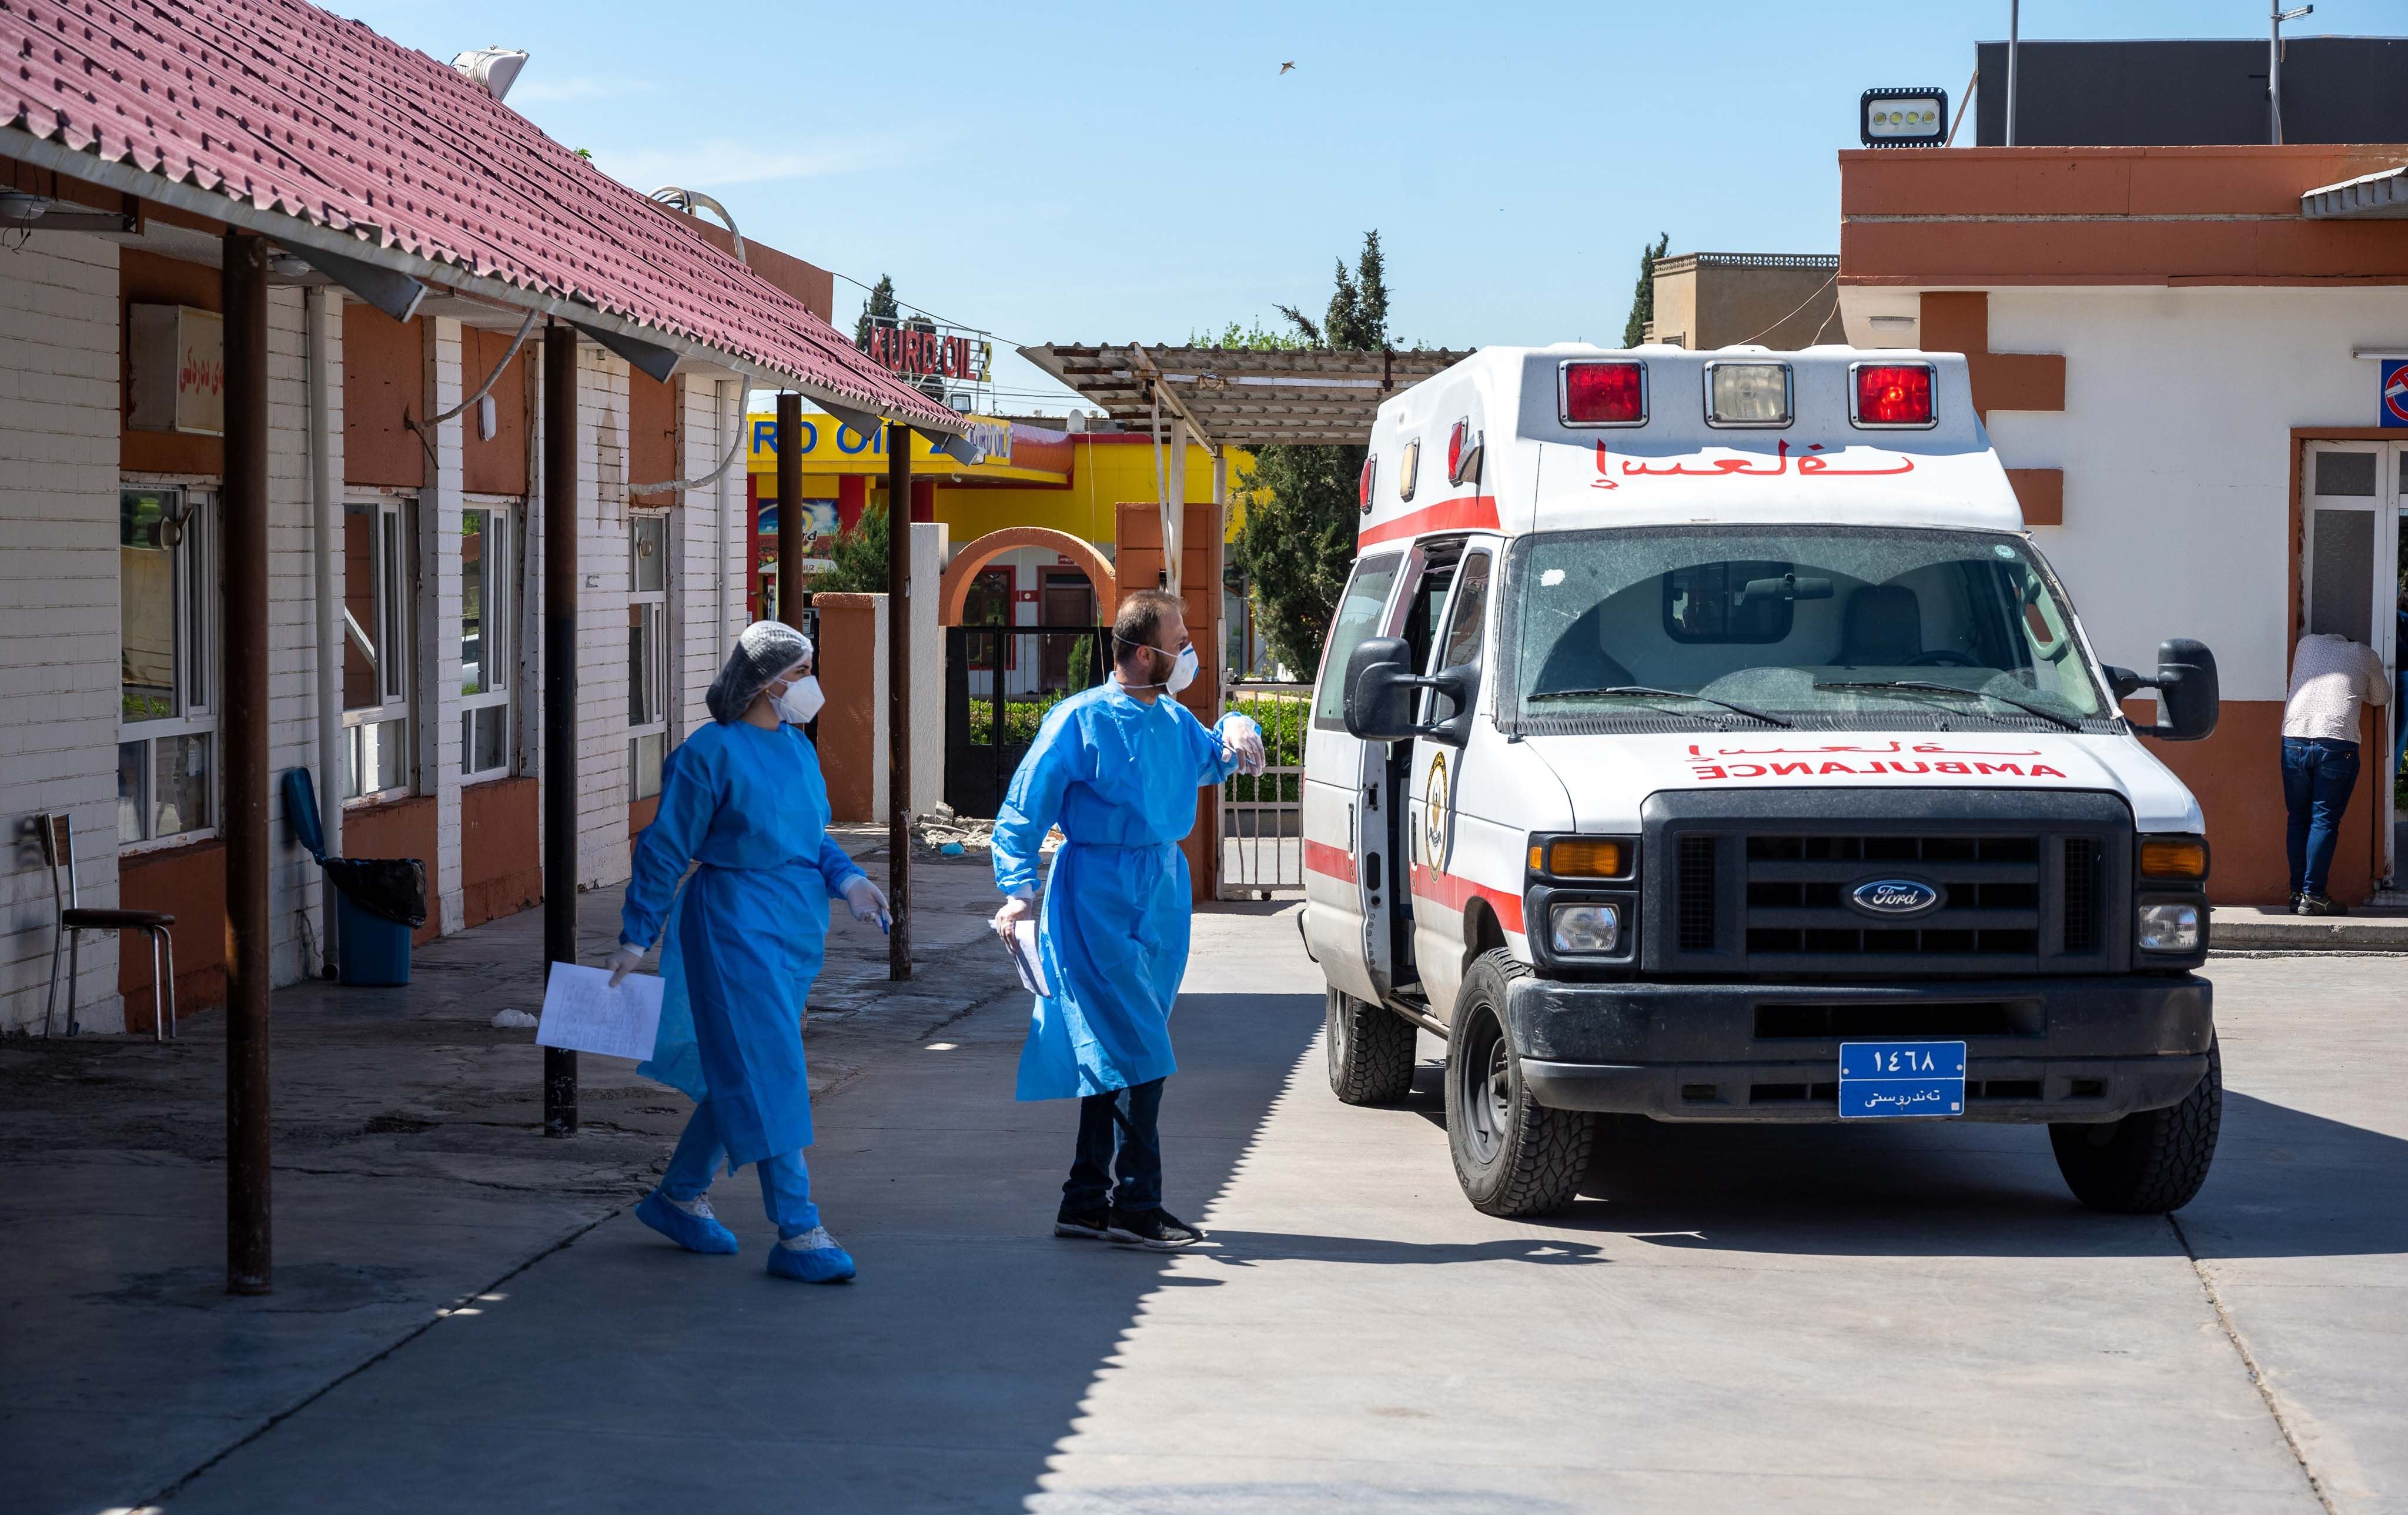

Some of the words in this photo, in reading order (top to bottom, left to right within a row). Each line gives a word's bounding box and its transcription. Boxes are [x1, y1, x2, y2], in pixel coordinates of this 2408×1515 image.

[870, 326, 937, 374] KURD
[944, 335, 976, 380] OIL
[982, 342, 992, 383] 2
[1872, 885, 1919, 905] Ford
[1874, 1051, 1935, 1072] ١٤٦٨
